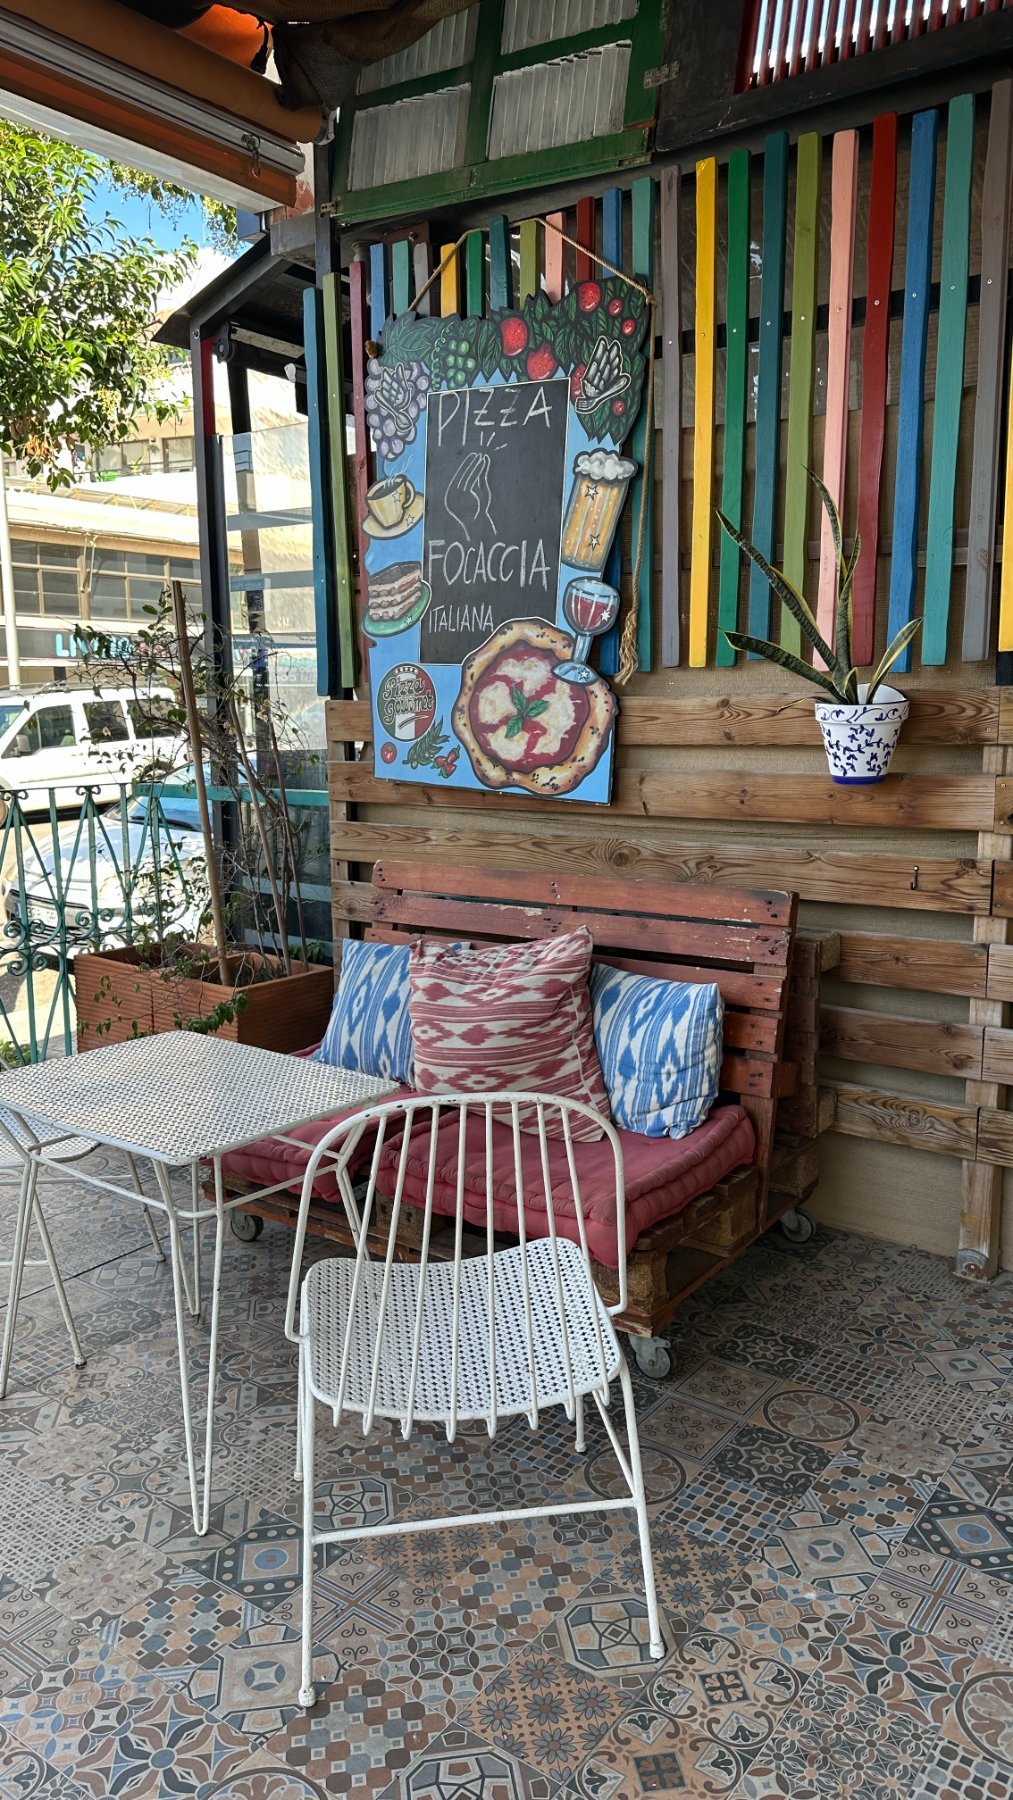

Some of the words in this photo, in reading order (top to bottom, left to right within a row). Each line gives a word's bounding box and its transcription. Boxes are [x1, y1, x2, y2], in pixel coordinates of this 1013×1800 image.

[438, 386, 552, 446] PIZZA
[428, 538, 551, 592] FOCACCIA
[428, 602, 494, 633] ITALIANA
[383, 677, 425, 699] Pizza
